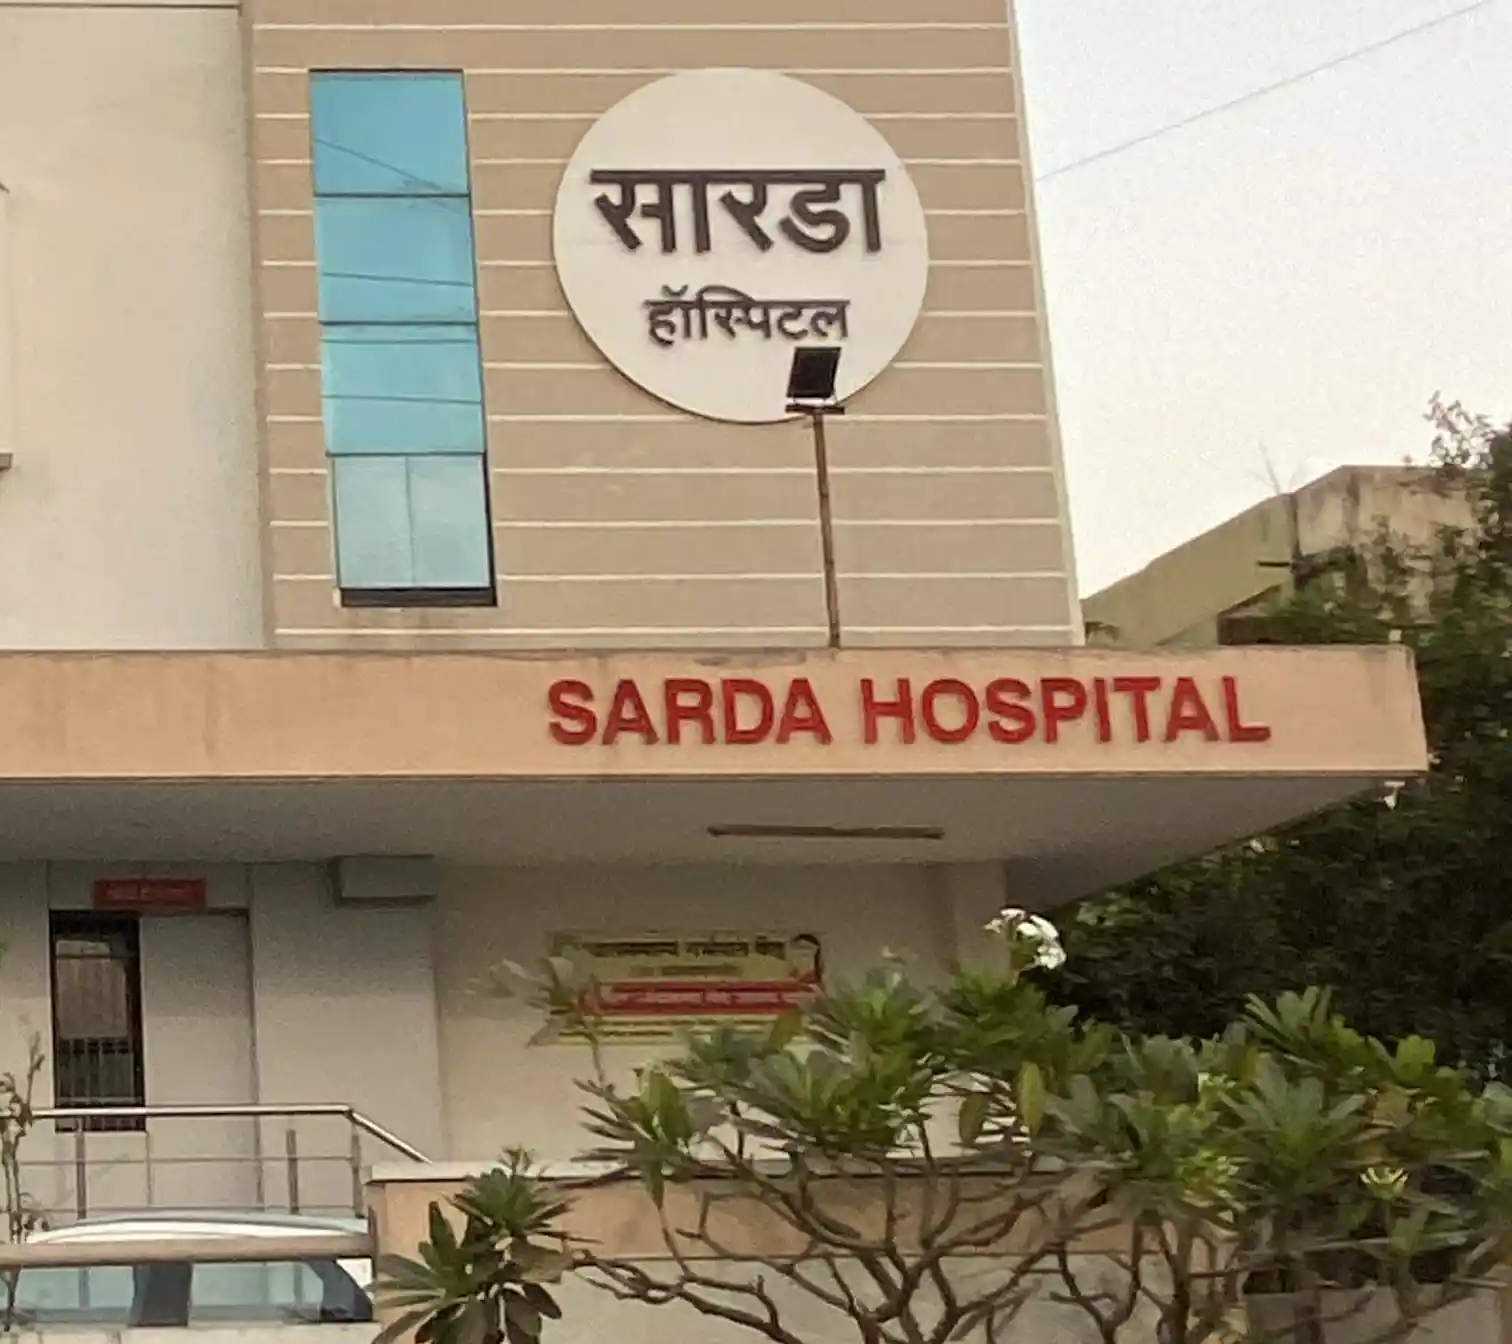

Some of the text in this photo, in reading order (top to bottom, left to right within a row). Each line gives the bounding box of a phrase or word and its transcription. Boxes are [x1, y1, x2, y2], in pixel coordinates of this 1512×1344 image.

[589, 168, 886, 255] सारडा
[642, 284, 851, 346] हॉस्पिटल
[547, 673, 1272, 746] SARDA HOSPITAL
